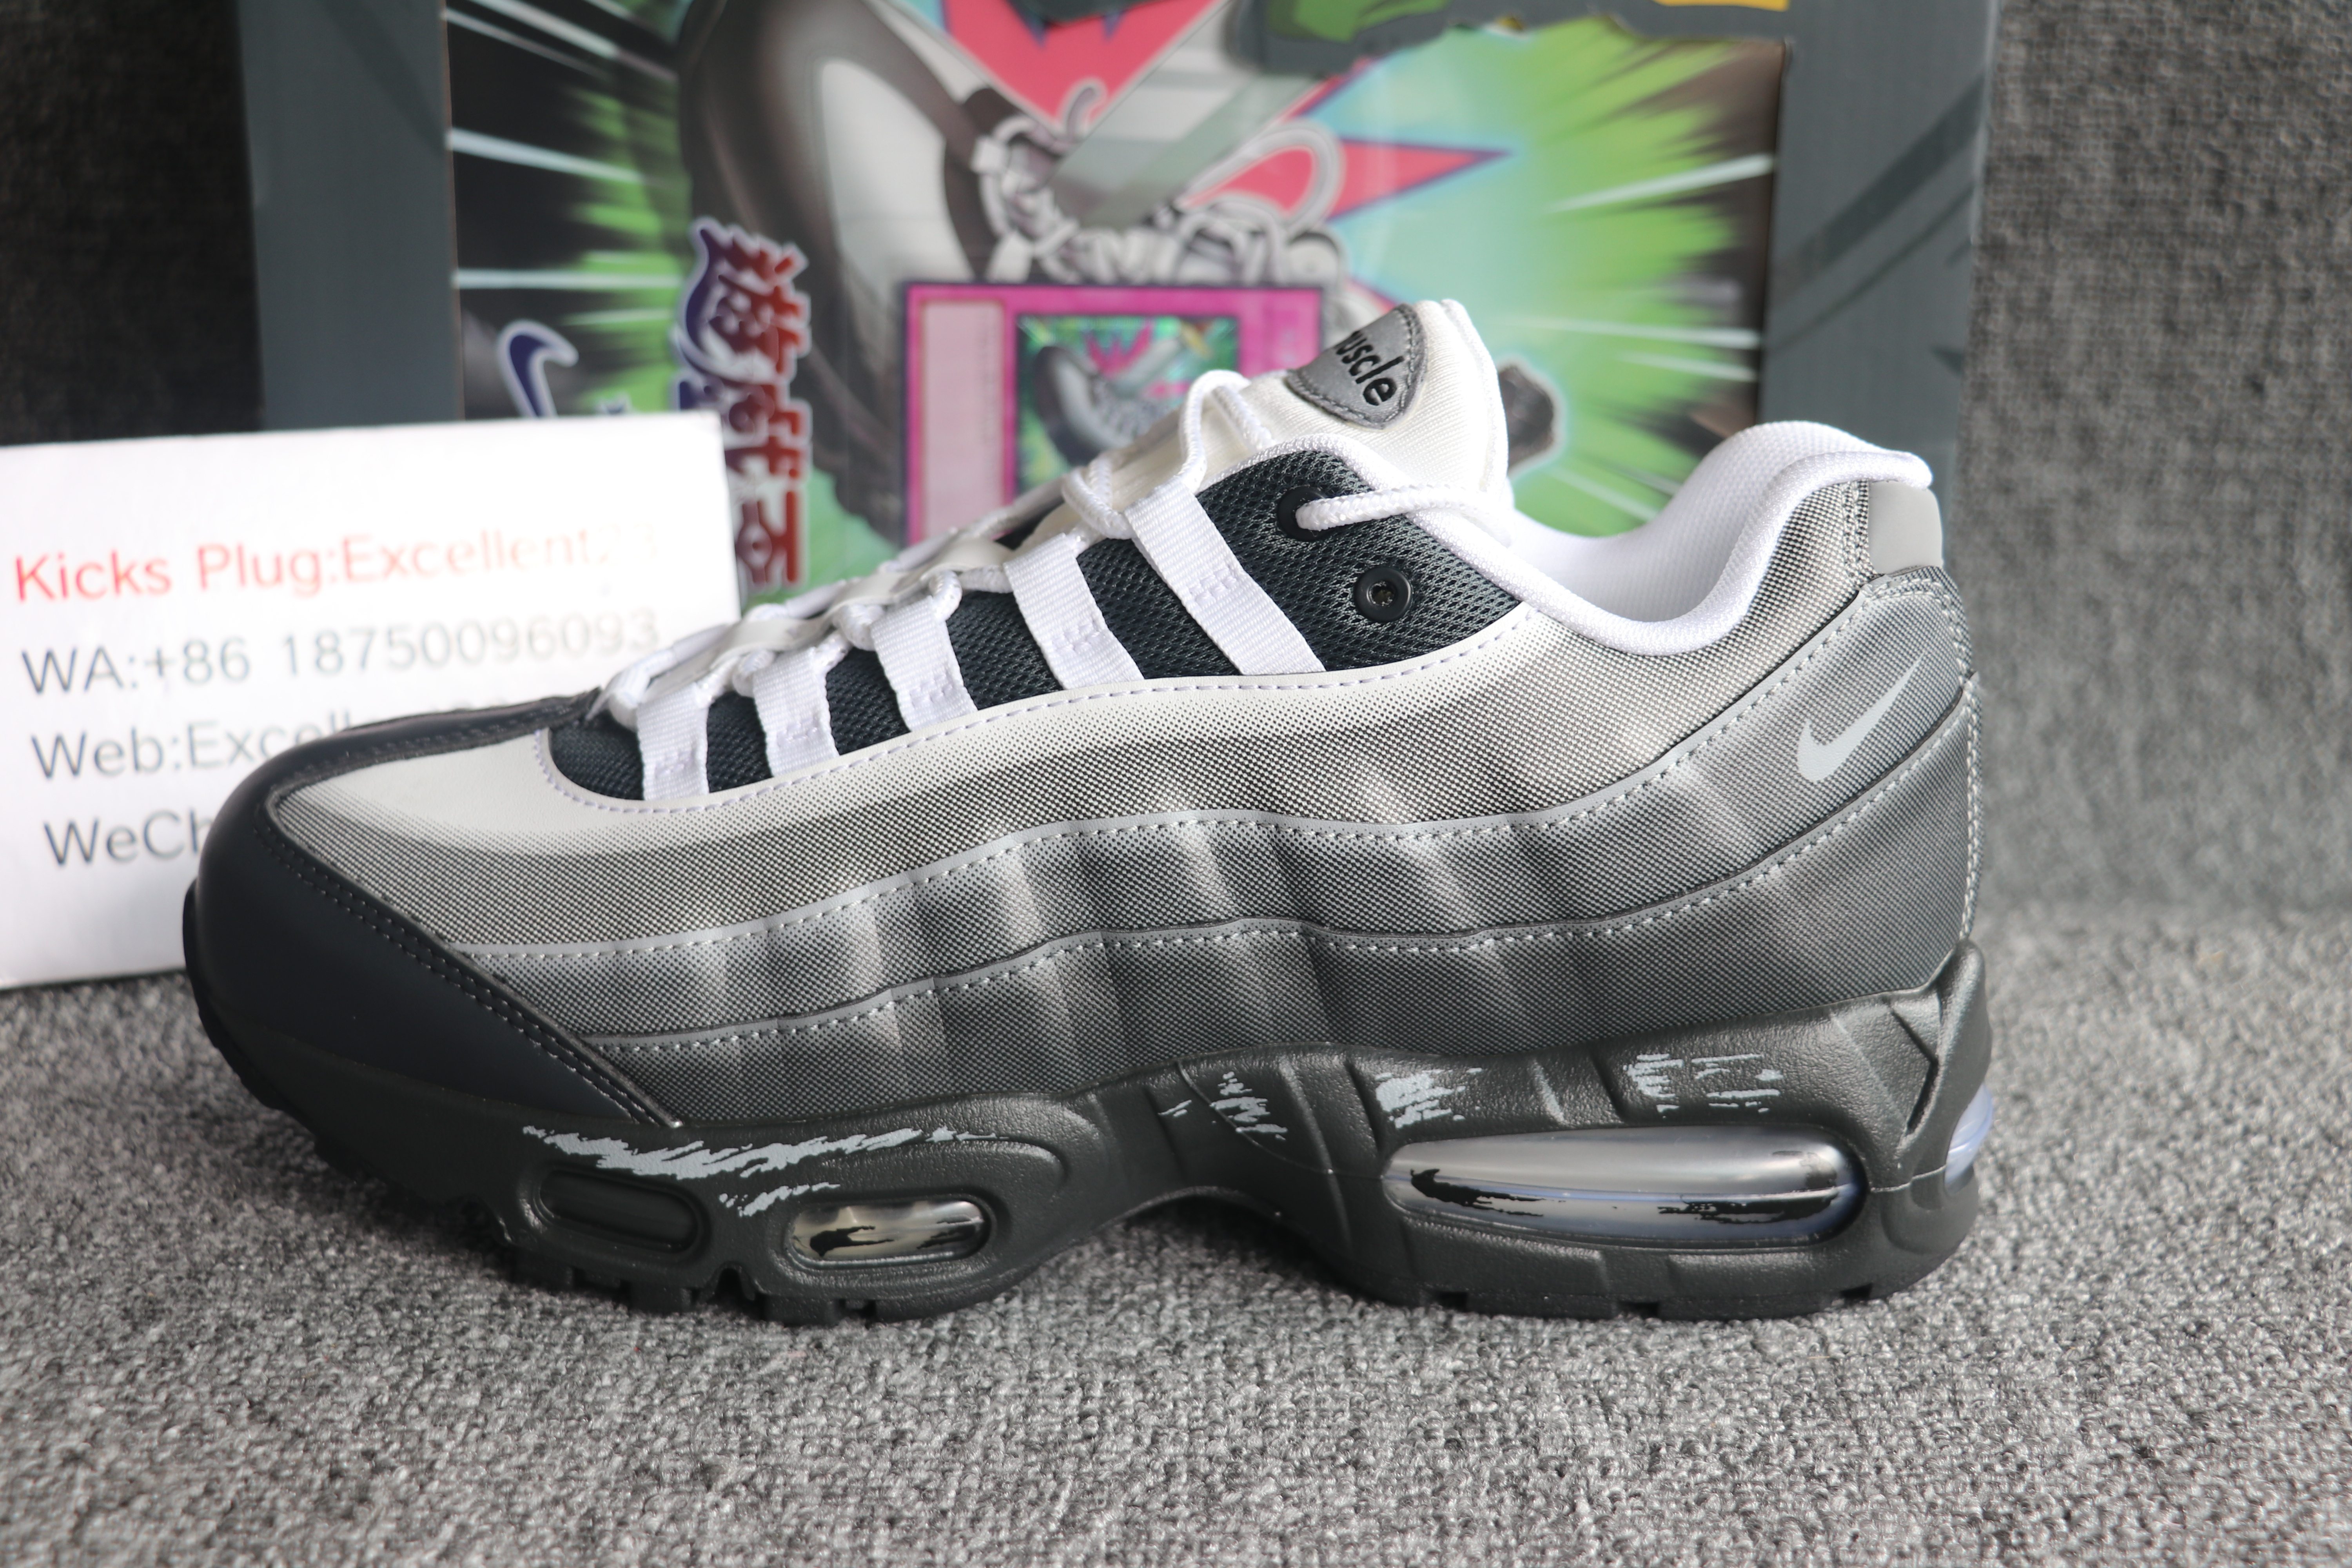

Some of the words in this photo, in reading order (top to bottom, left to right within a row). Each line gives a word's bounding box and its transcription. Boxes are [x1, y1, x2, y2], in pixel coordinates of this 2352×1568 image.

[1333, 330, 1405, 407] uscle
[14, 548, 172, 604] Kicks
[21, 636, 252, 695] WA:+86
[282, 606, 660, 677] 18750096093
